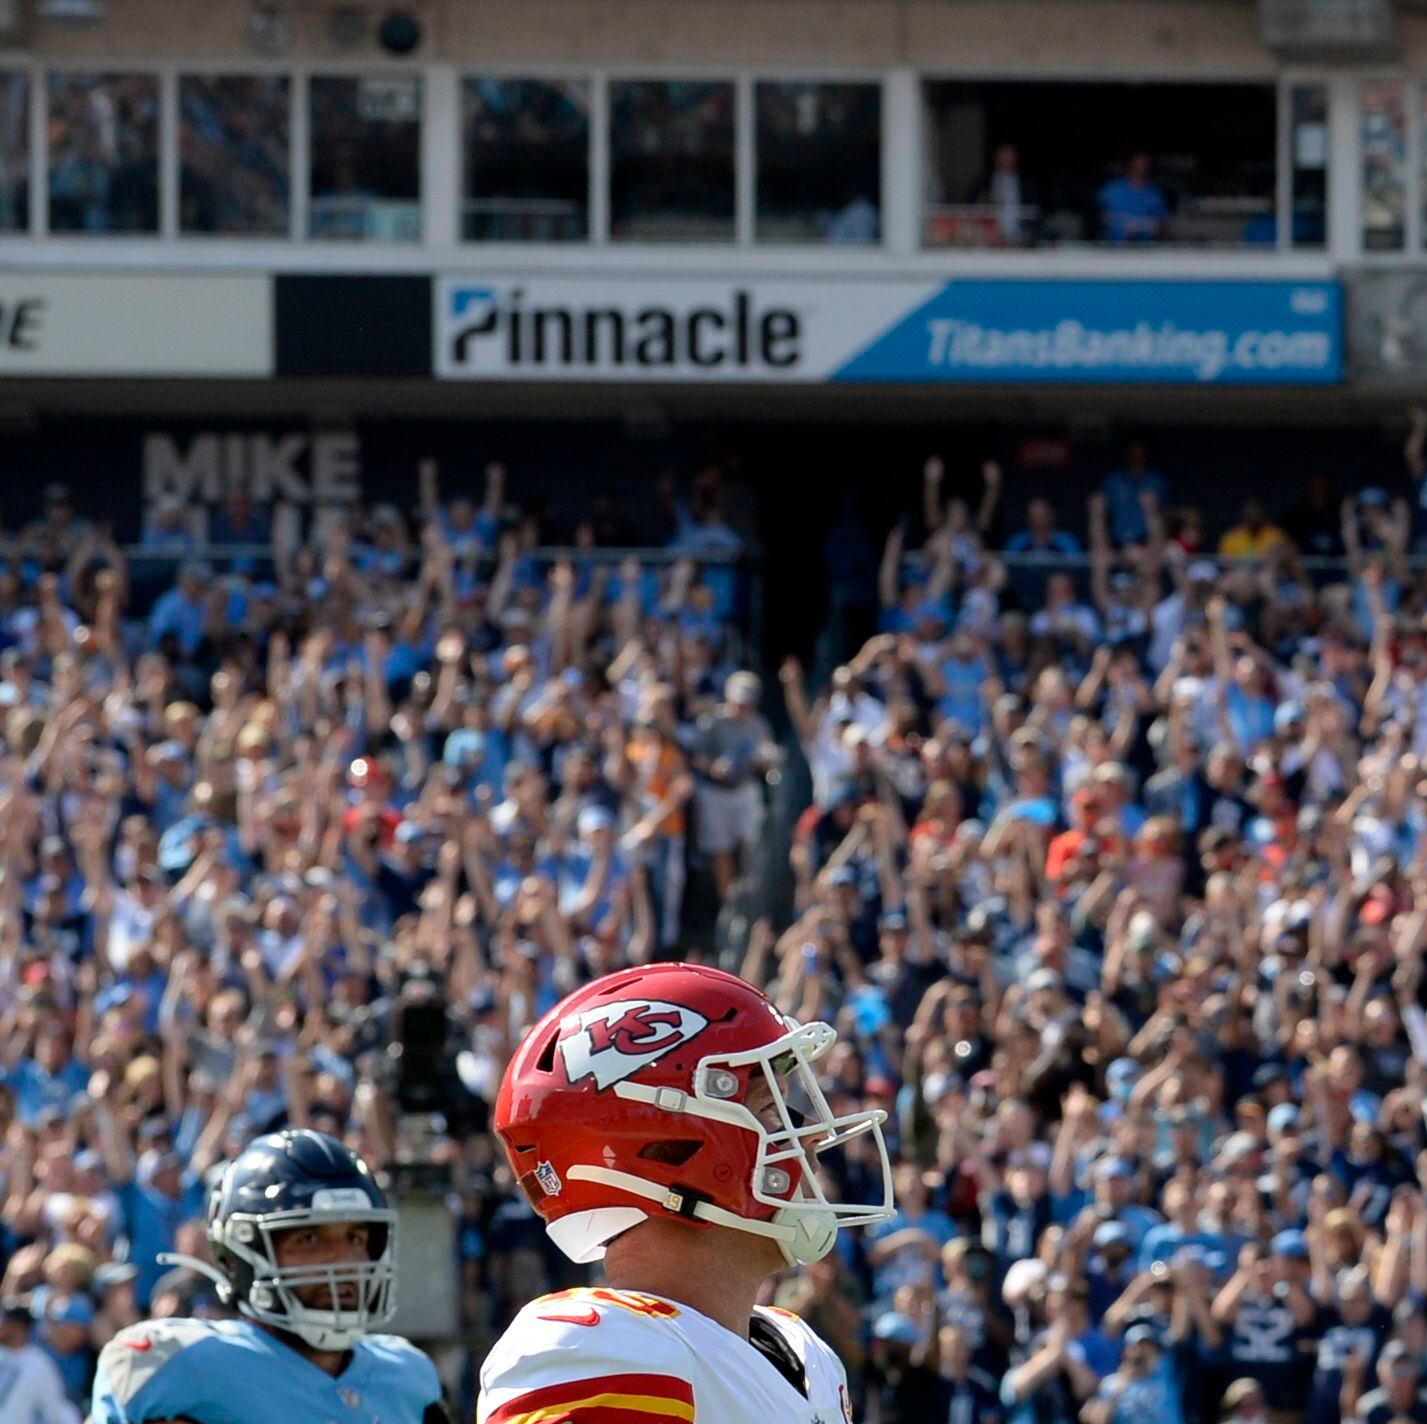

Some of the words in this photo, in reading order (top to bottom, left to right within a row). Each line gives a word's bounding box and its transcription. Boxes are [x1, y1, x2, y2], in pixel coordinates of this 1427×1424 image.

[450, 285, 803, 367] Pinnacle
[929, 318, 1331, 382] TitansBanking.com
[143, 433, 361, 501] MIKE
